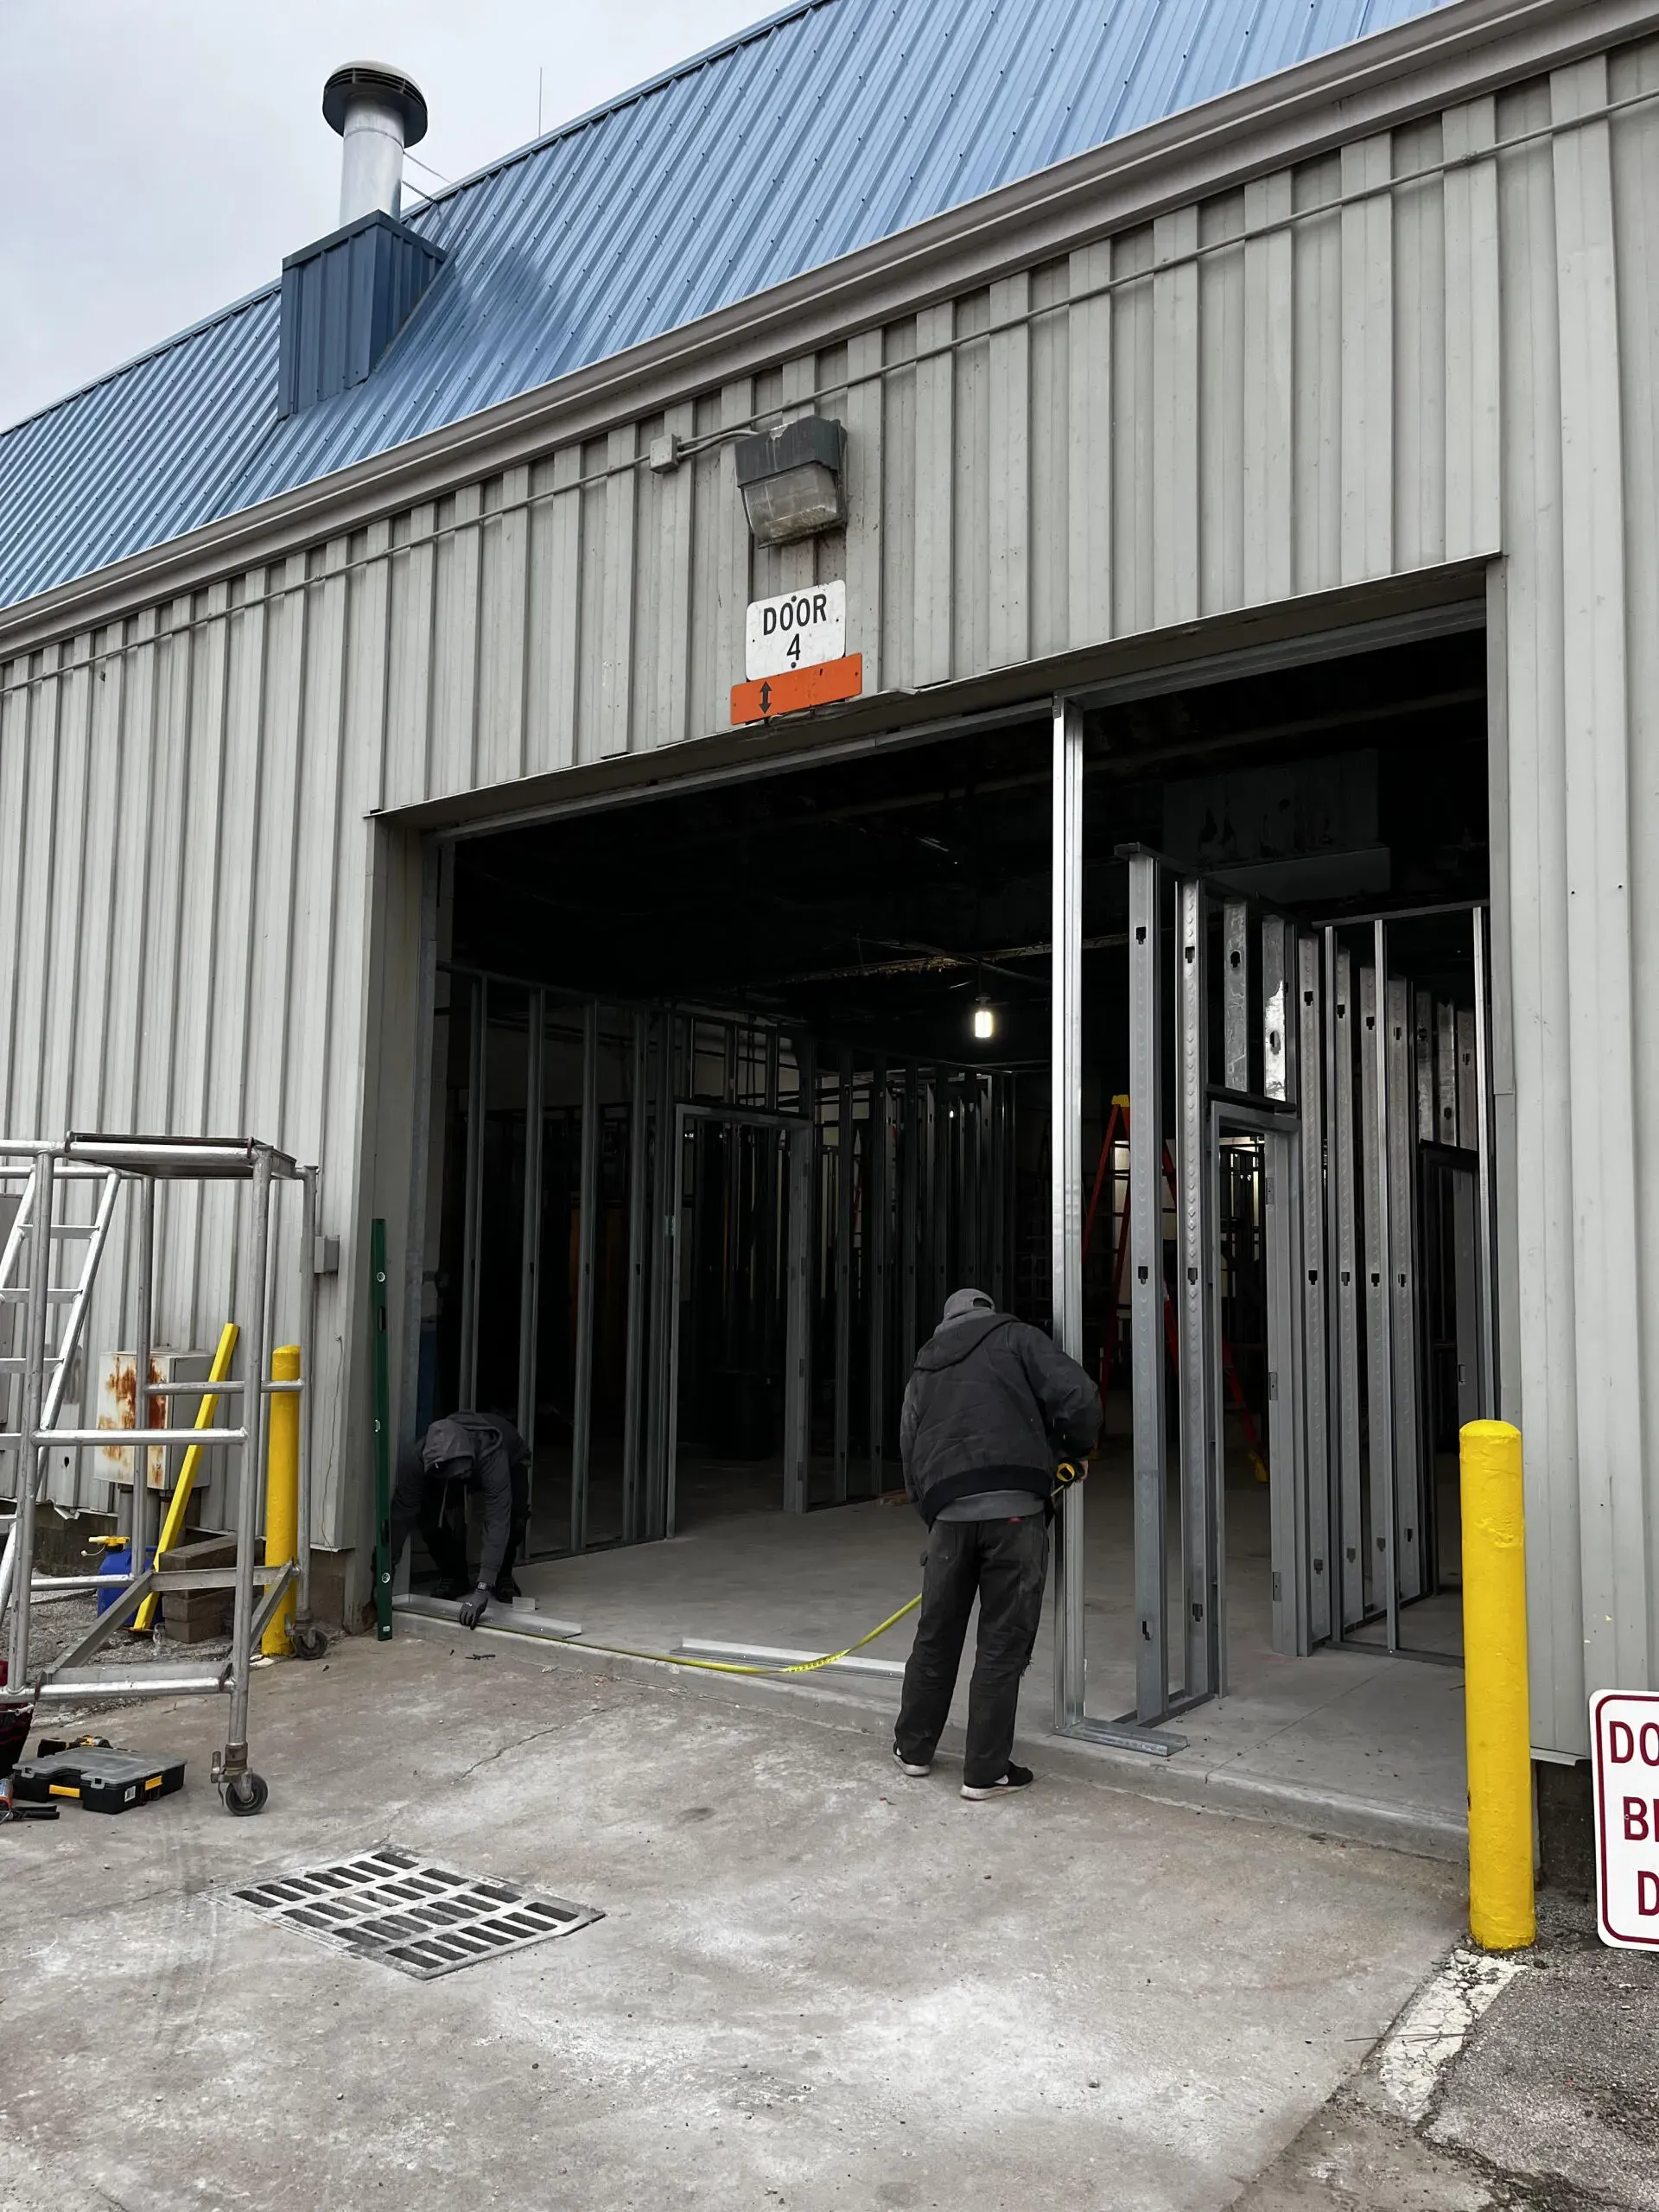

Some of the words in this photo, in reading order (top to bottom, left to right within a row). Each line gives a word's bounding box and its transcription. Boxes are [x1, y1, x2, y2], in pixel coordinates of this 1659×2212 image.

[763, 594, 827, 636] DOOR
[786, 632, 801, 661] 4
[1609, 1720, 1659, 1767] DO
[1623, 1796, 1659, 1842] B
